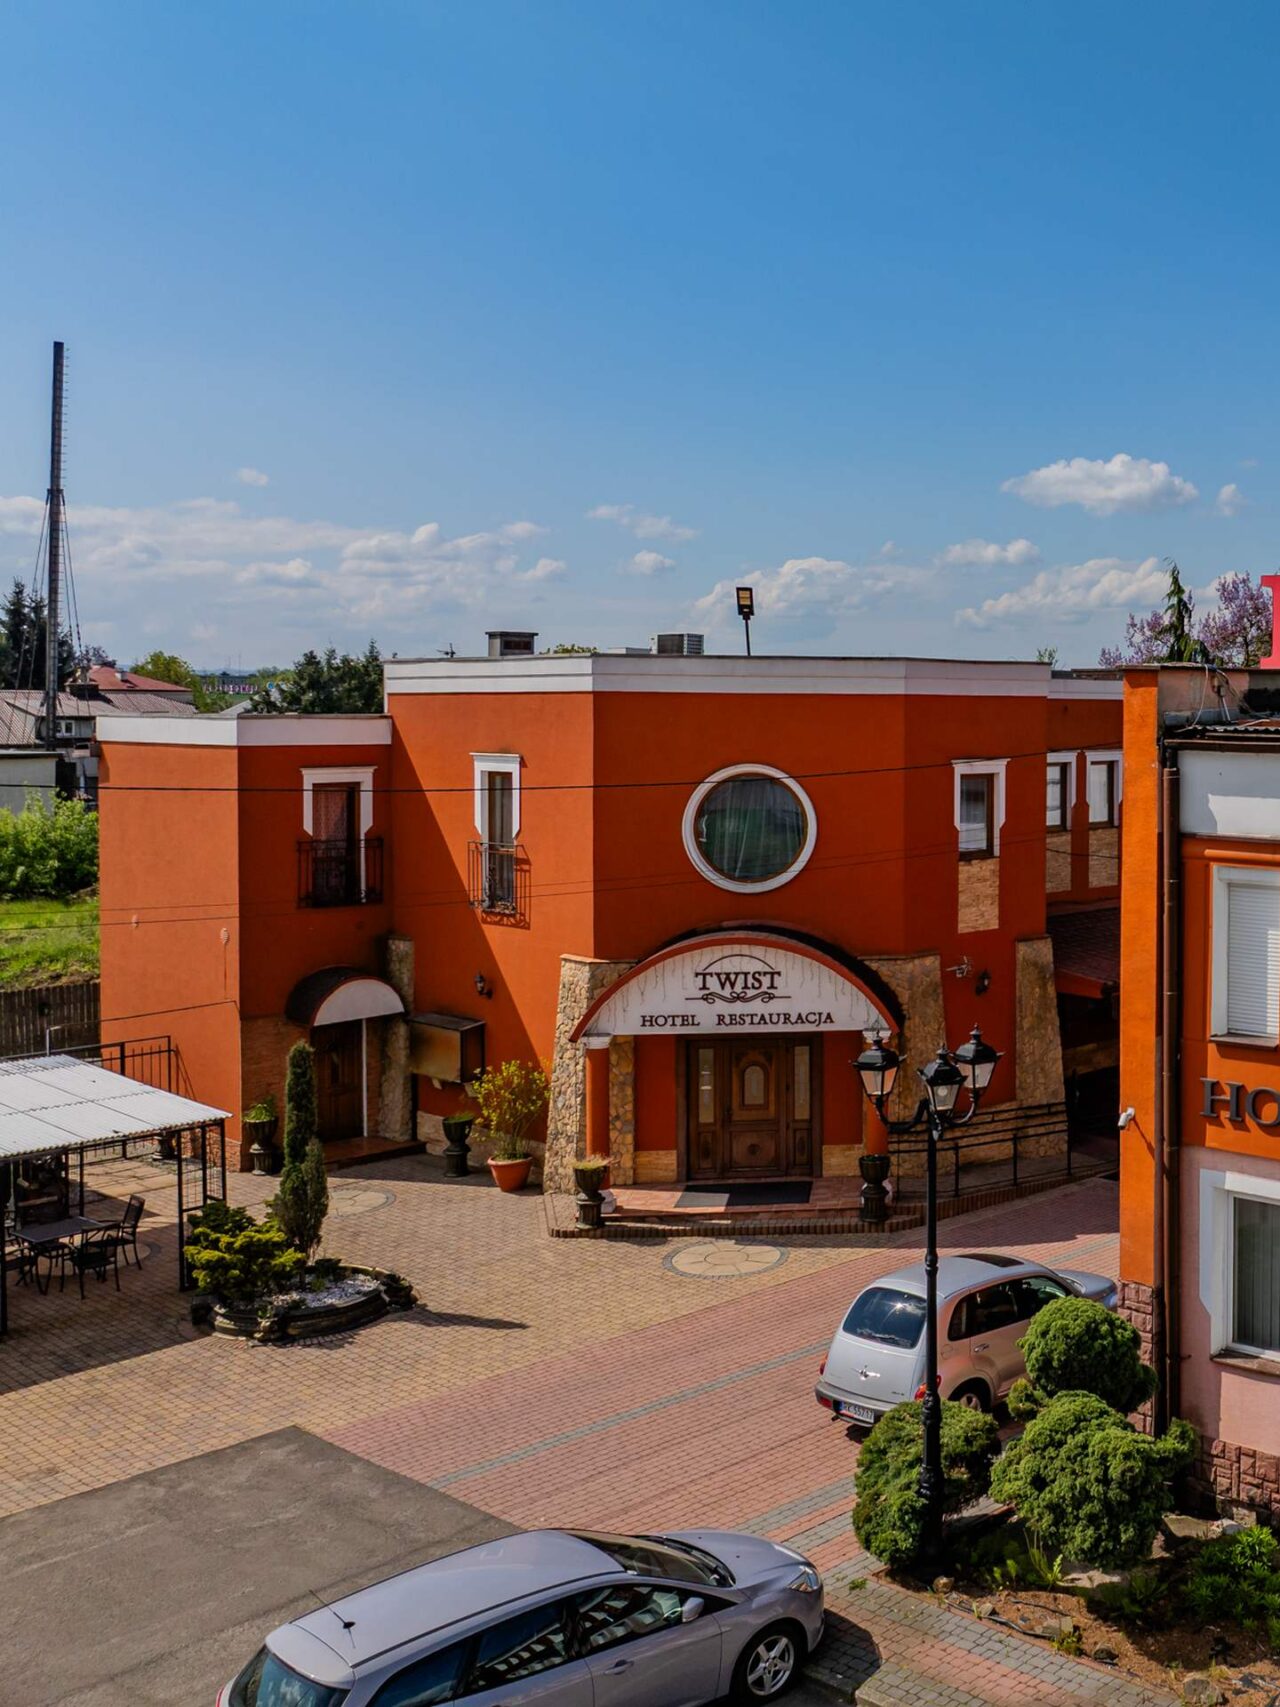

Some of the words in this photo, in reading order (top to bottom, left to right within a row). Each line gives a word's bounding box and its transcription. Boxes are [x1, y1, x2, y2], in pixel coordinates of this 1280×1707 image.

[695, 970, 782, 991] TWIST
[640, 1013, 700, 1027] HOTEL
[715, 1011, 834, 1027] RESTAURACJA
